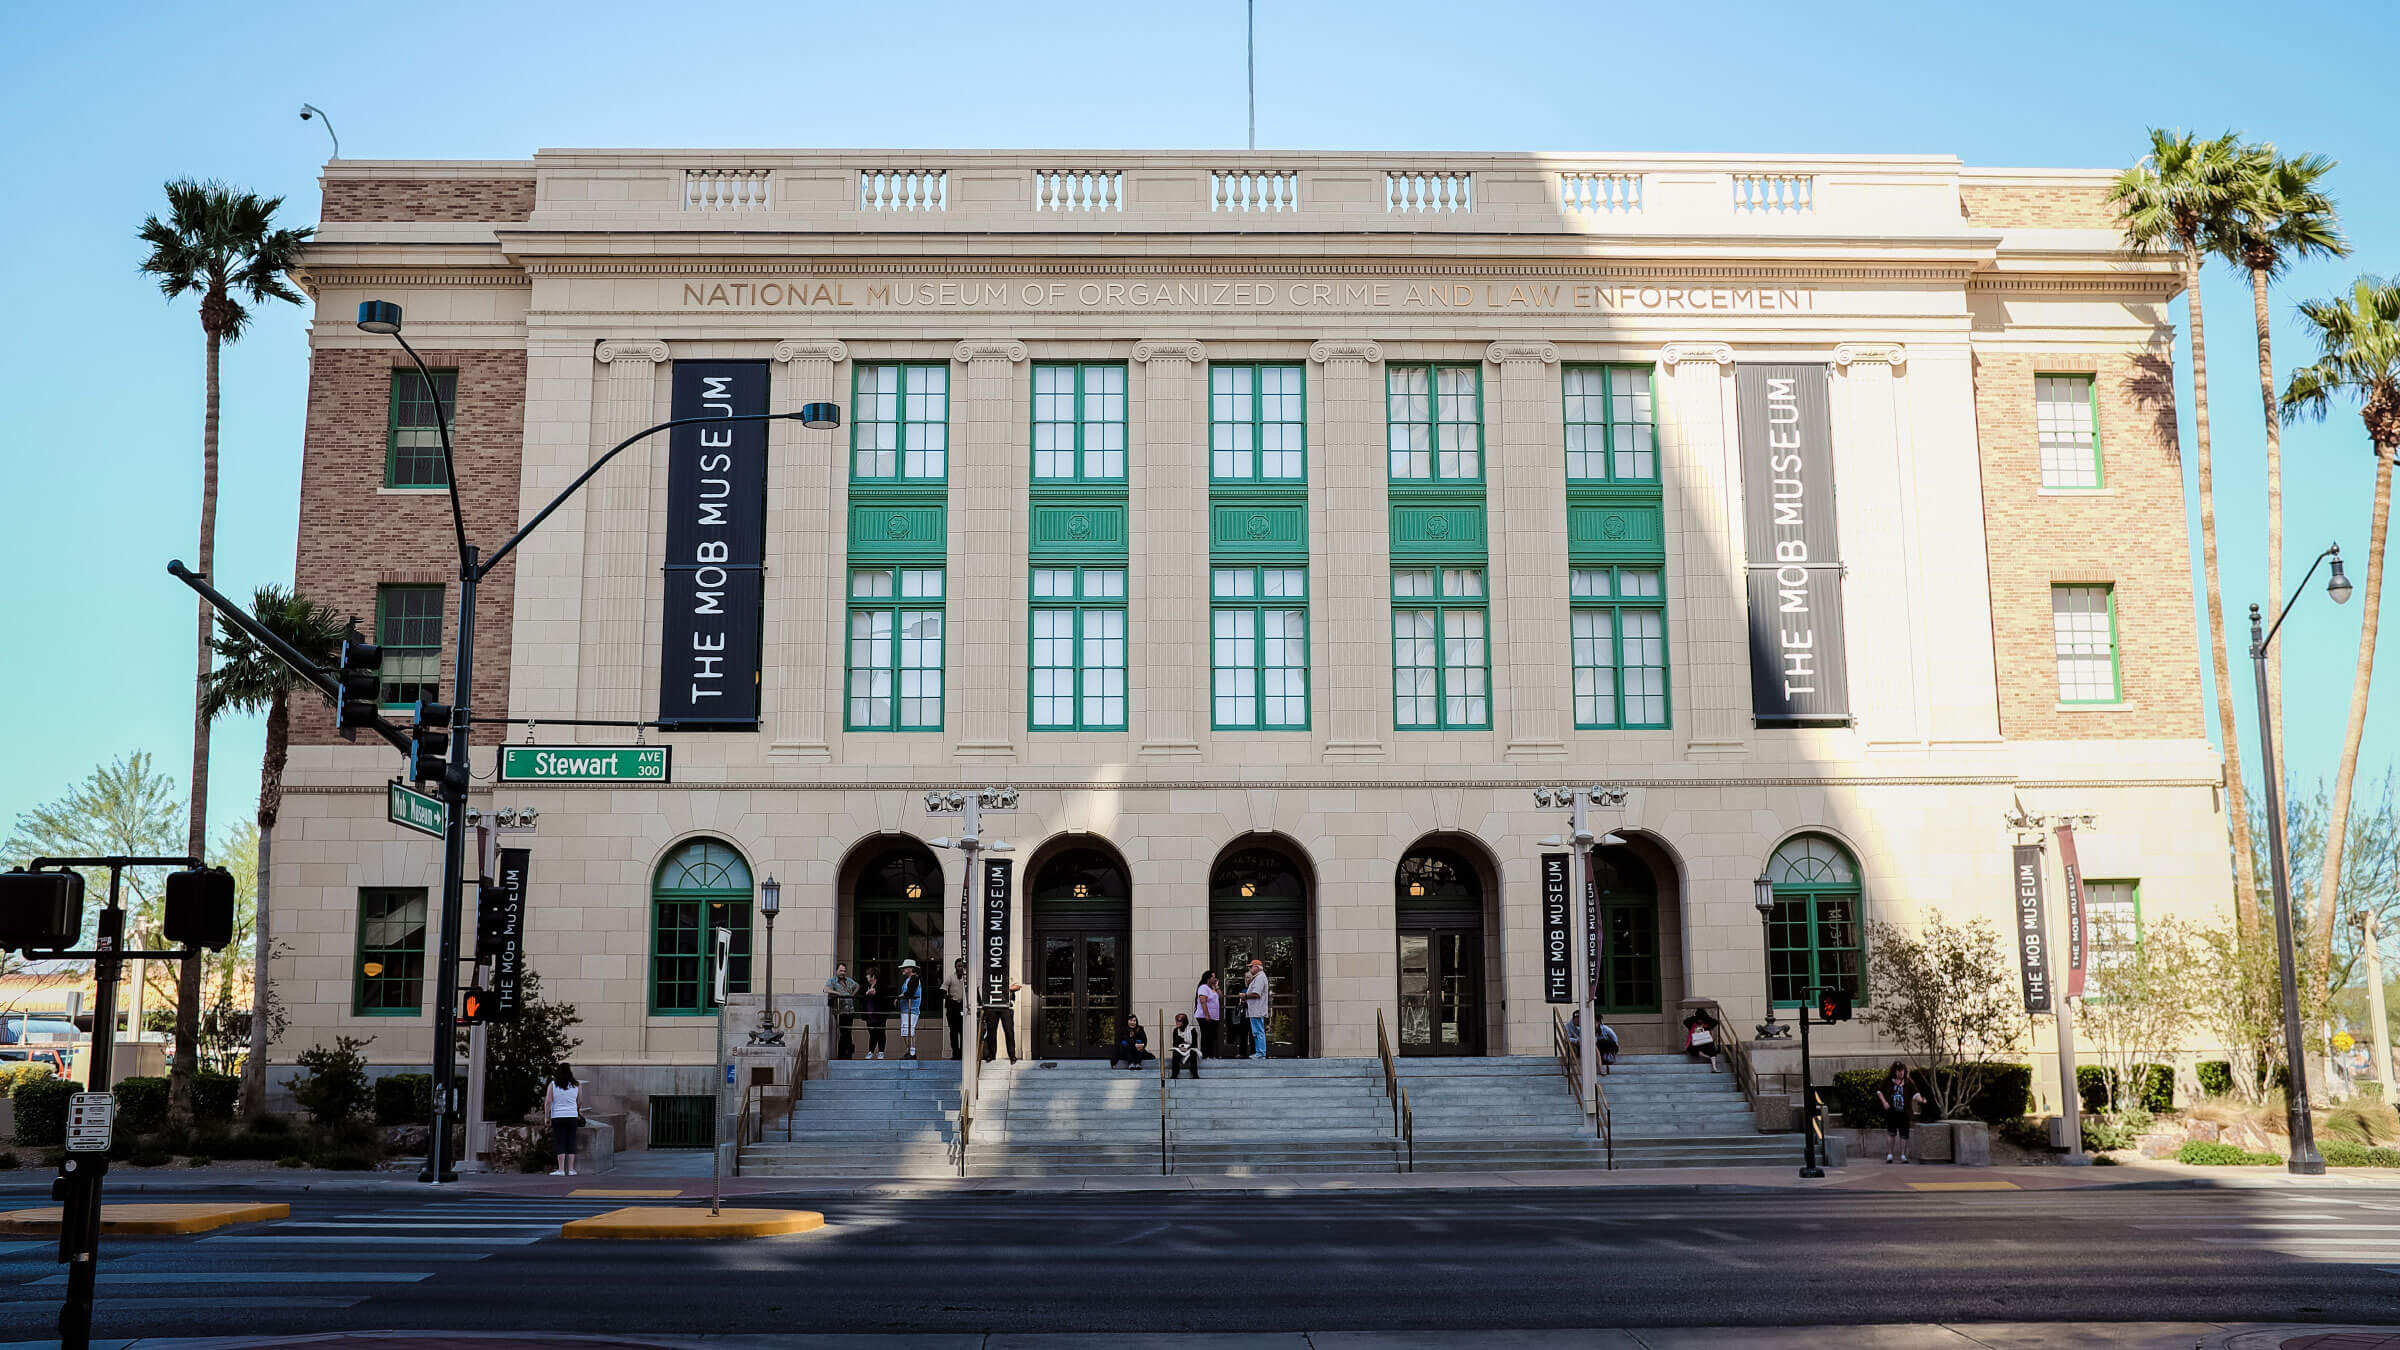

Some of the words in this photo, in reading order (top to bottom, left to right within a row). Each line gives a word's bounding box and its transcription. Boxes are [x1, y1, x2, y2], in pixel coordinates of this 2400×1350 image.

[684, 283, 853, 306] NATIONAL
[866, 283, 1008, 306] MUSEUM
[1021, 283, 1066, 306] OF
[1078, 283, 1275, 306] ORGANIZED
[1289, 283, 1390, 306] CRIME
[1403, 284, 1473, 307] AND
[1487, 285, 1560, 307] LAW
[1574, 285, 1818, 310] ENFORCEMENT
[698, 376, 733, 525] MUSEUM
[1766, 377, 1804, 525] MUSEUM
[694, 540, 729, 614] MOB
[1775, 539, 1809, 613] MOB
[691, 631, 725, 705] THE
[1781, 629, 1815, 701] THE
[508, 753, 516, 762] E
[534, 752, 618, 776] Stewart
[638, 752, 662, 763] AVE
[638, 766, 660, 777] 300
[394, 790, 407, 818] Mob
[410, 796, 433, 827] Museum
[503, 870, 520, 935] MUSEUM
[990, 867, 1005, 931] MUSEUM
[1548, 861, 1564, 925] MUSEUM
[1587, 882, 1596, 930] MUSEUM
[2020, 864, 2037, 930] MUSEUM
[2066, 866, 2078, 915] MUSEUM
[990, 936, 1003, 968] MOB
[1550, 930, 1565, 962] MOB
[2025, 933, 2041, 967] MOB
[2072, 944, 2080, 968] THE
[500, 978, 514, 1010] THE
[989, 973, 1003, 1004] THE
[1551, 967, 1566, 998] THE
[2028, 971, 2044, 1004] THE
